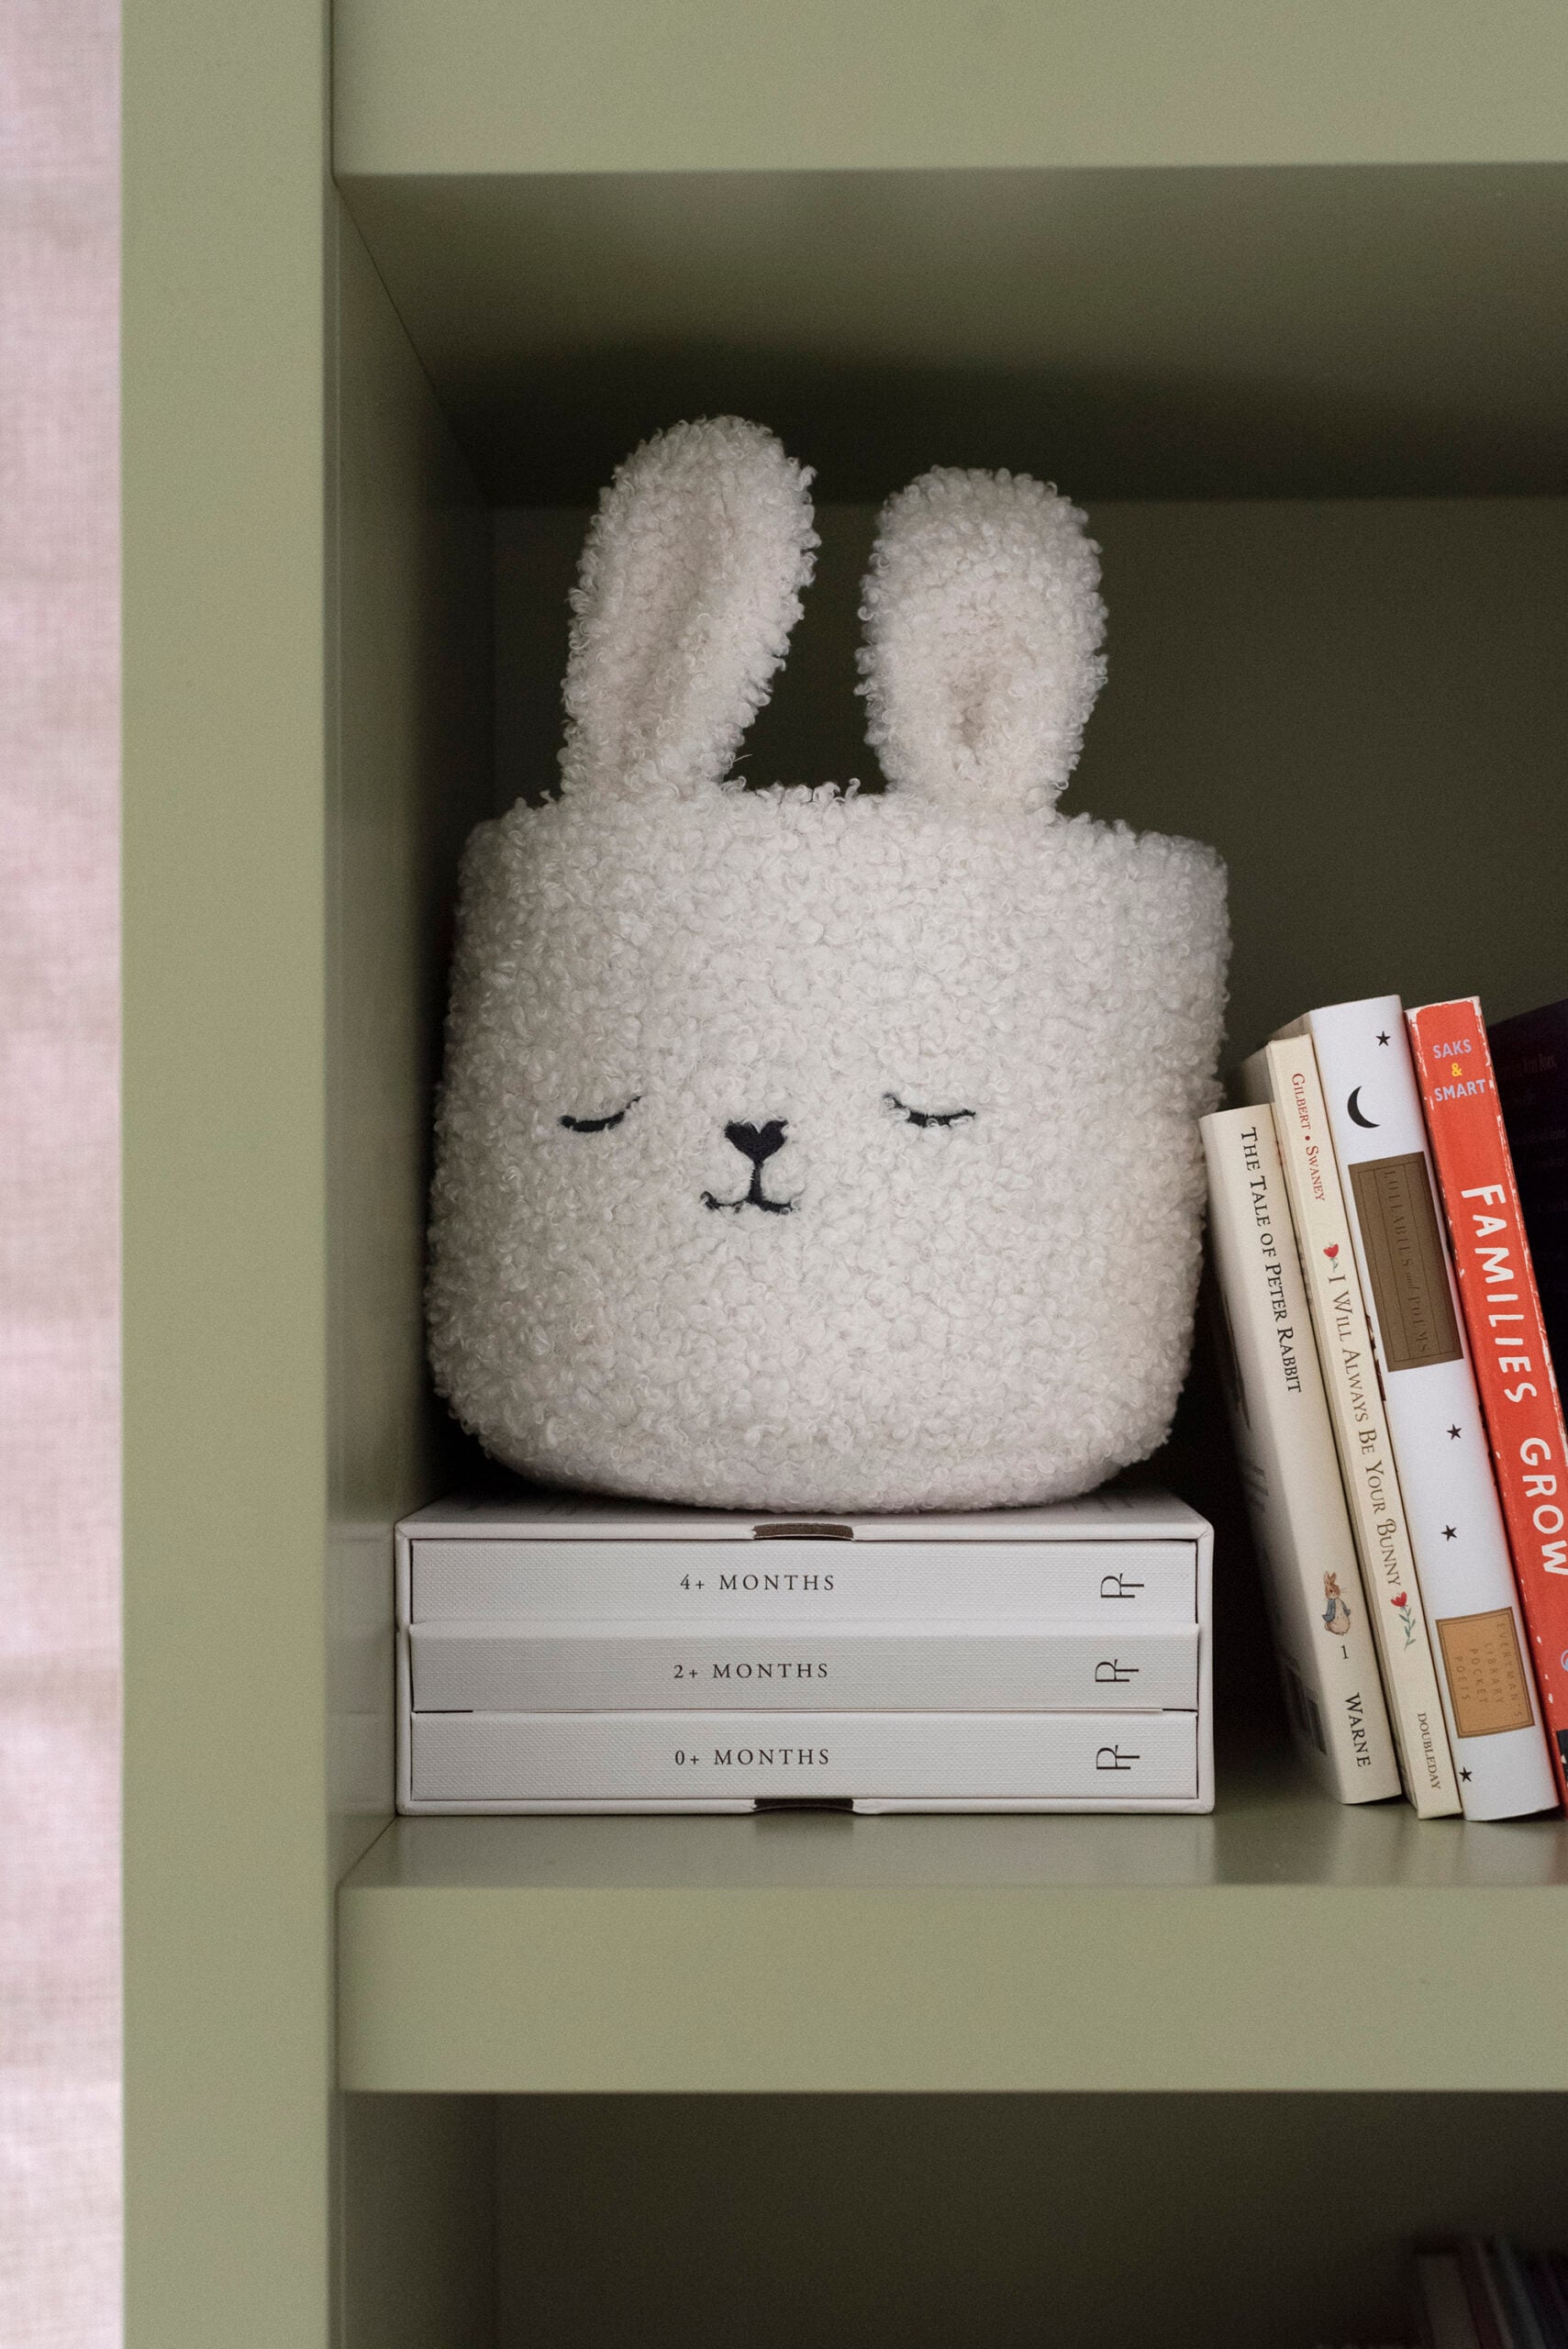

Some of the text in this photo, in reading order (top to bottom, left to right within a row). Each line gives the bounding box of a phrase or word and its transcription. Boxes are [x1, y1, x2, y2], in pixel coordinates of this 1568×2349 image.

[1432, 1039, 1473, 1060] SAKS
[1451, 1063, 1463, 1078] &
[1434, 1079, 1486, 1102] SMART
[1241, 1127, 1302, 1394] THE TALE OF PETER RABBIT
[1462, 1184, 1568, 1575] FAMILIES GROW
[1329, 1275, 1402, 1586] I WILL ALWAYS BE YOUR BUNNY
[680, 1574, 835, 1591] 4+ MONTHS
[673, 1662, 828, 1679] 2+ MONTHS
[1454, 1655, 1472, 1701] POETS
[1469, 1648, 1488, 1703] POCKET
[1344, 1692, 1372, 1768] WARNE
[1418, 1712, 1441, 1791] DOUBLEDAY
[714, 1748, 830, 1766] MONTHS
